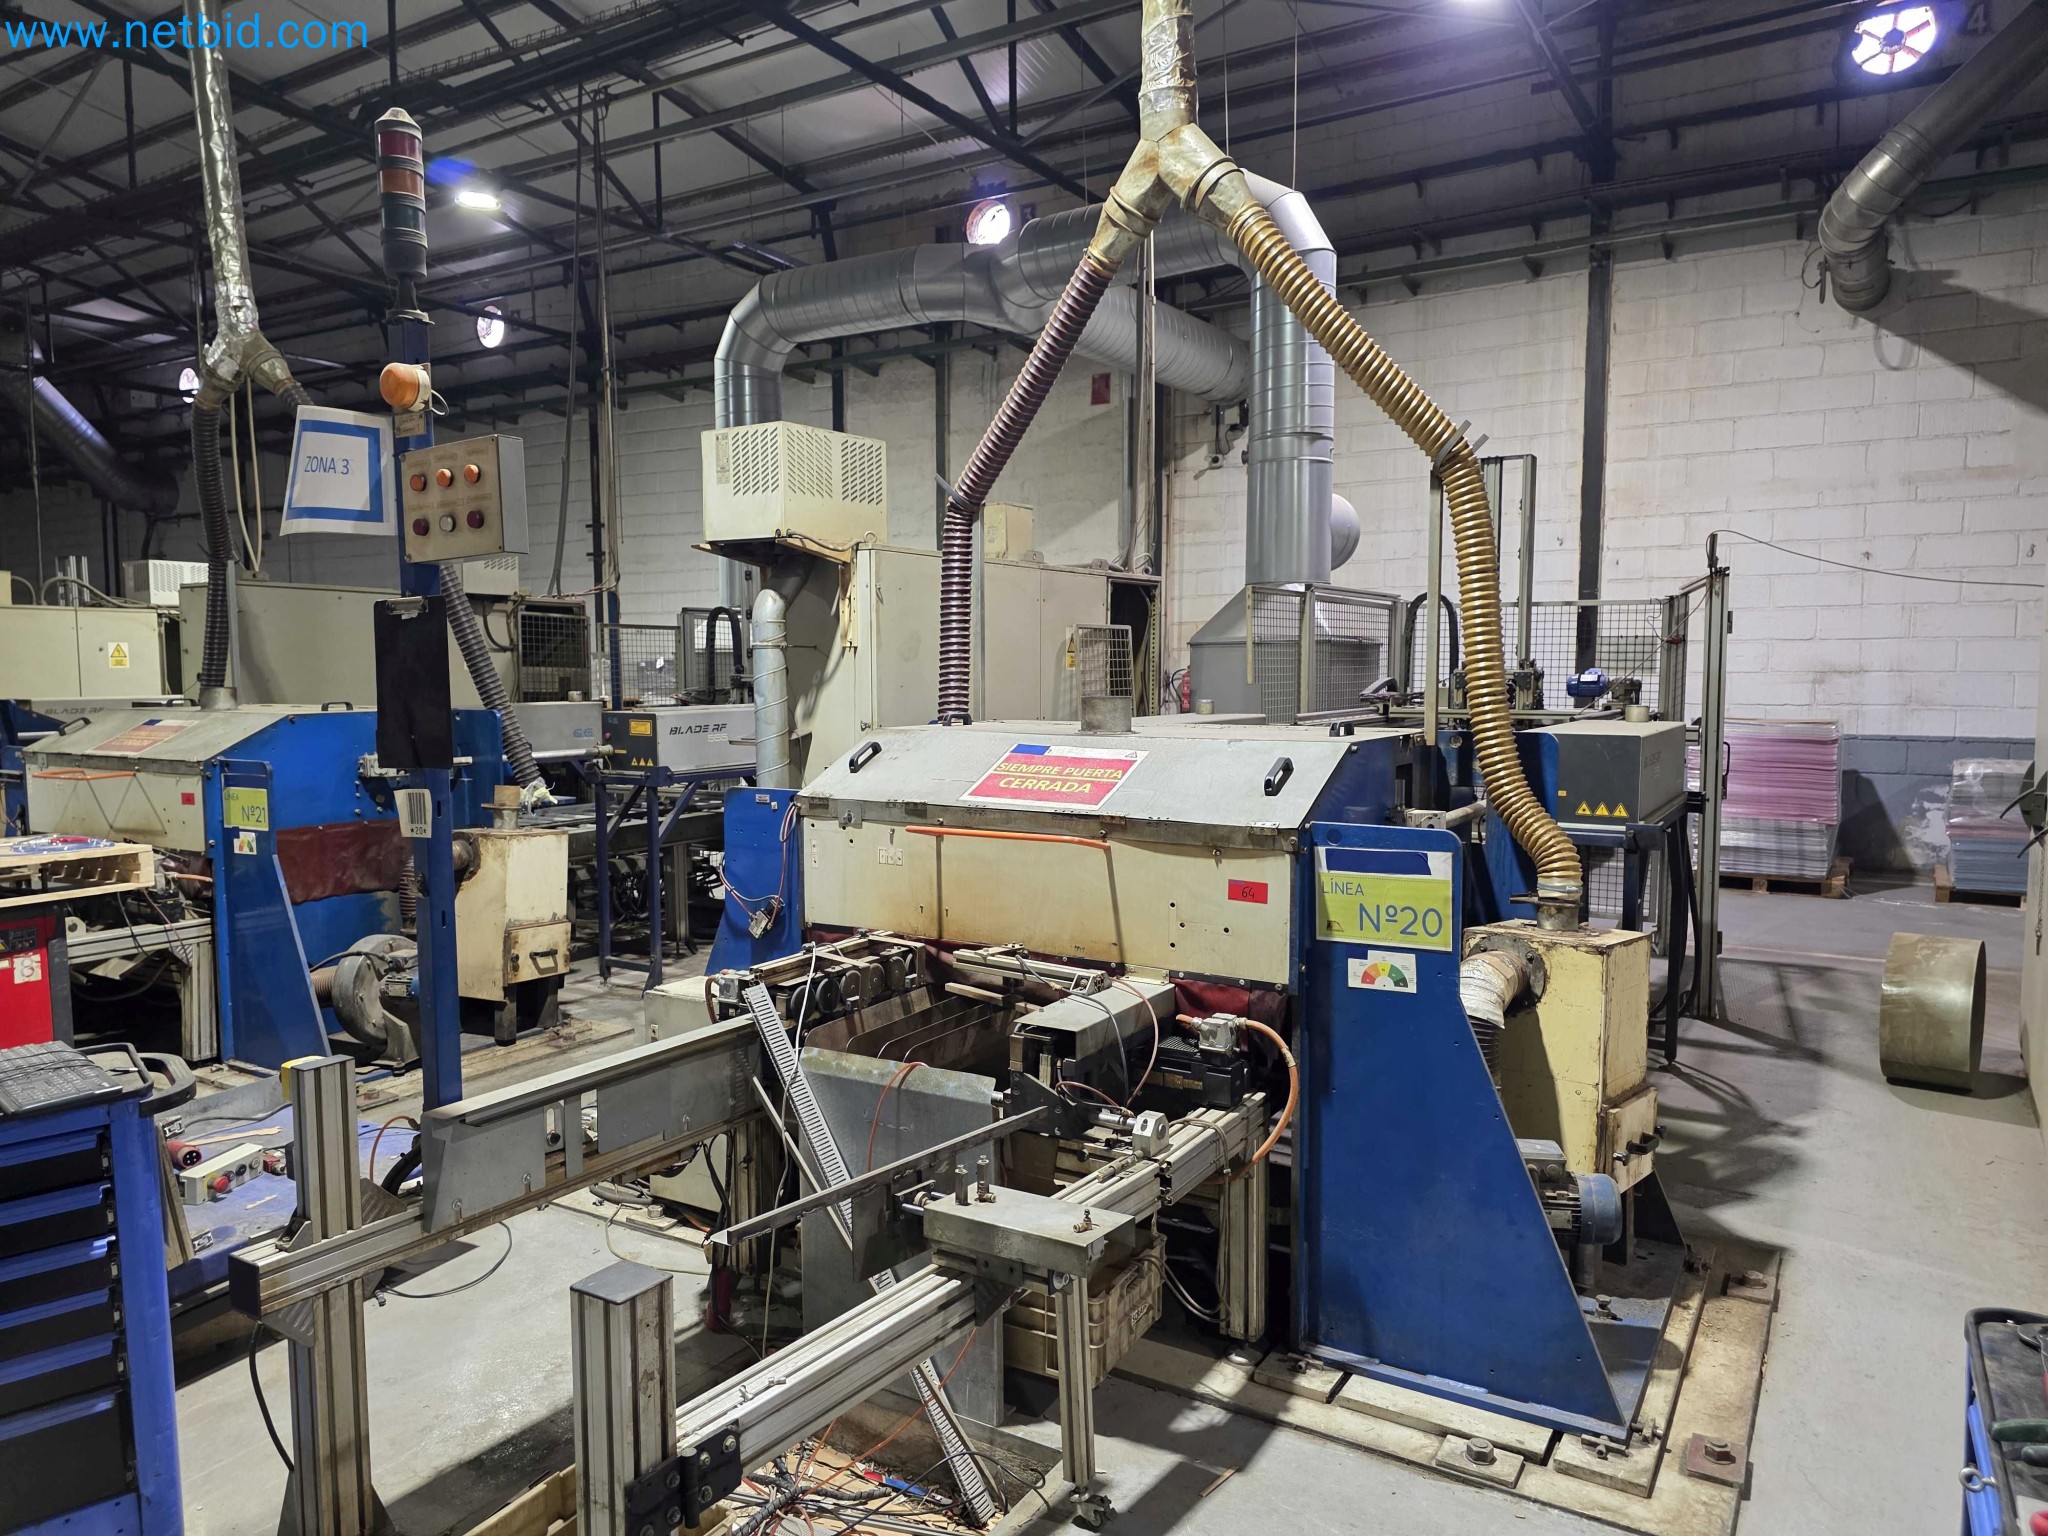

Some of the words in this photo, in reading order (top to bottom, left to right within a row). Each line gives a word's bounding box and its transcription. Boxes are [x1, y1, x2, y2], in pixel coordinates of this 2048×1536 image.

[1967, 4, 1988, 34] 4
[304, 456, 336, 474] ZONA
[341, 458, 350, 475] 3
[669, 724, 710, 736] BLADE
[711, 723, 728, 733] RF
[996, 762, 1061, 776] SIEMPRE
[1063, 767, 1123, 779] PUERTA
[998, 776, 1092, 793] CERRADA
[1241, 886, 1255, 899] 64
[1321, 878, 1365, 897] LÍNEA
